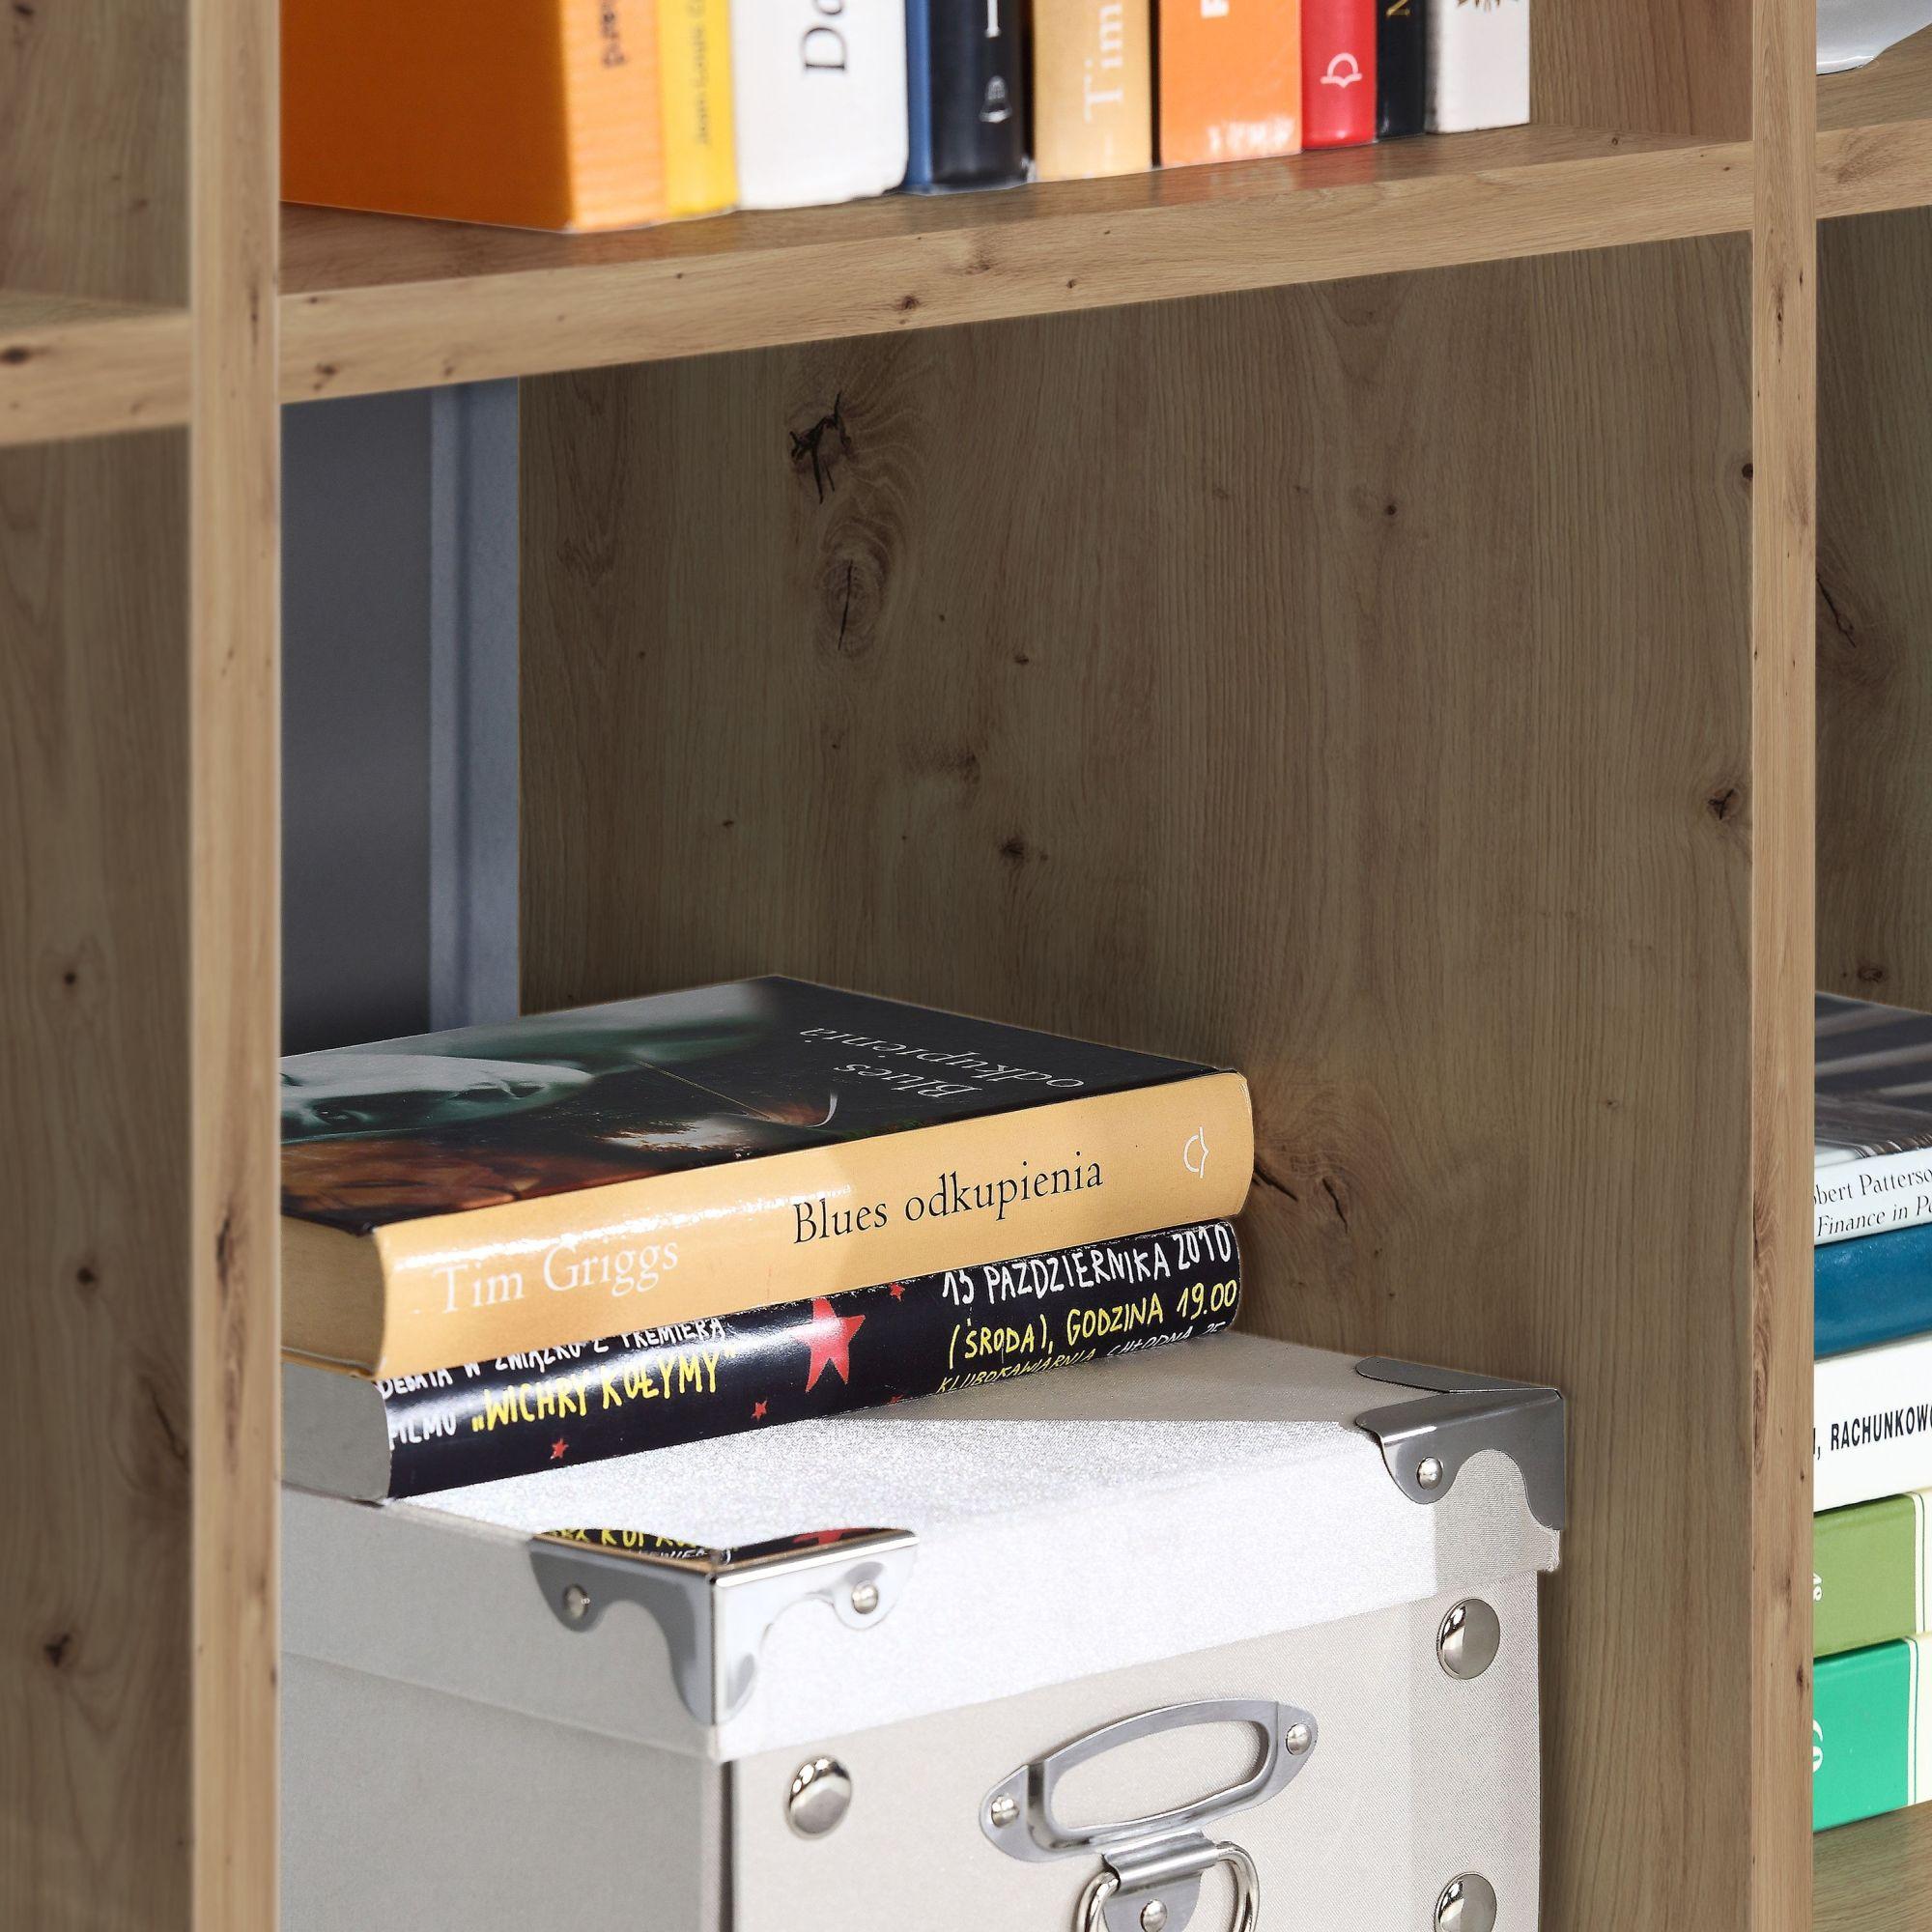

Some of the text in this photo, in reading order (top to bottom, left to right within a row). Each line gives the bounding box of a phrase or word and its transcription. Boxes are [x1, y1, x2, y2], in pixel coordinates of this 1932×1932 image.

[1083, 3, 1123, 123] Tim
[800, 1027, 1084, 1088] odkupienia
[834, 1064, 982, 1097] Blues
[793, 1151, 1103, 1244] Blues odkupienia
[1817, 1211, 1886, 1236] Finance
[1892, 1204, 1908, 1221] in
[432, 1240, 678, 1314] Tim Griggs
[942, 1268, 974, 1306] 15
[1171, 1223, 1233, 1272] 2010
[1066, 1292, 1164, 1347] GODZINA
[1177, 1278, 1237, 1320] 19.00
[1831, 1403, 1932, 1451] RACHUNKOW
